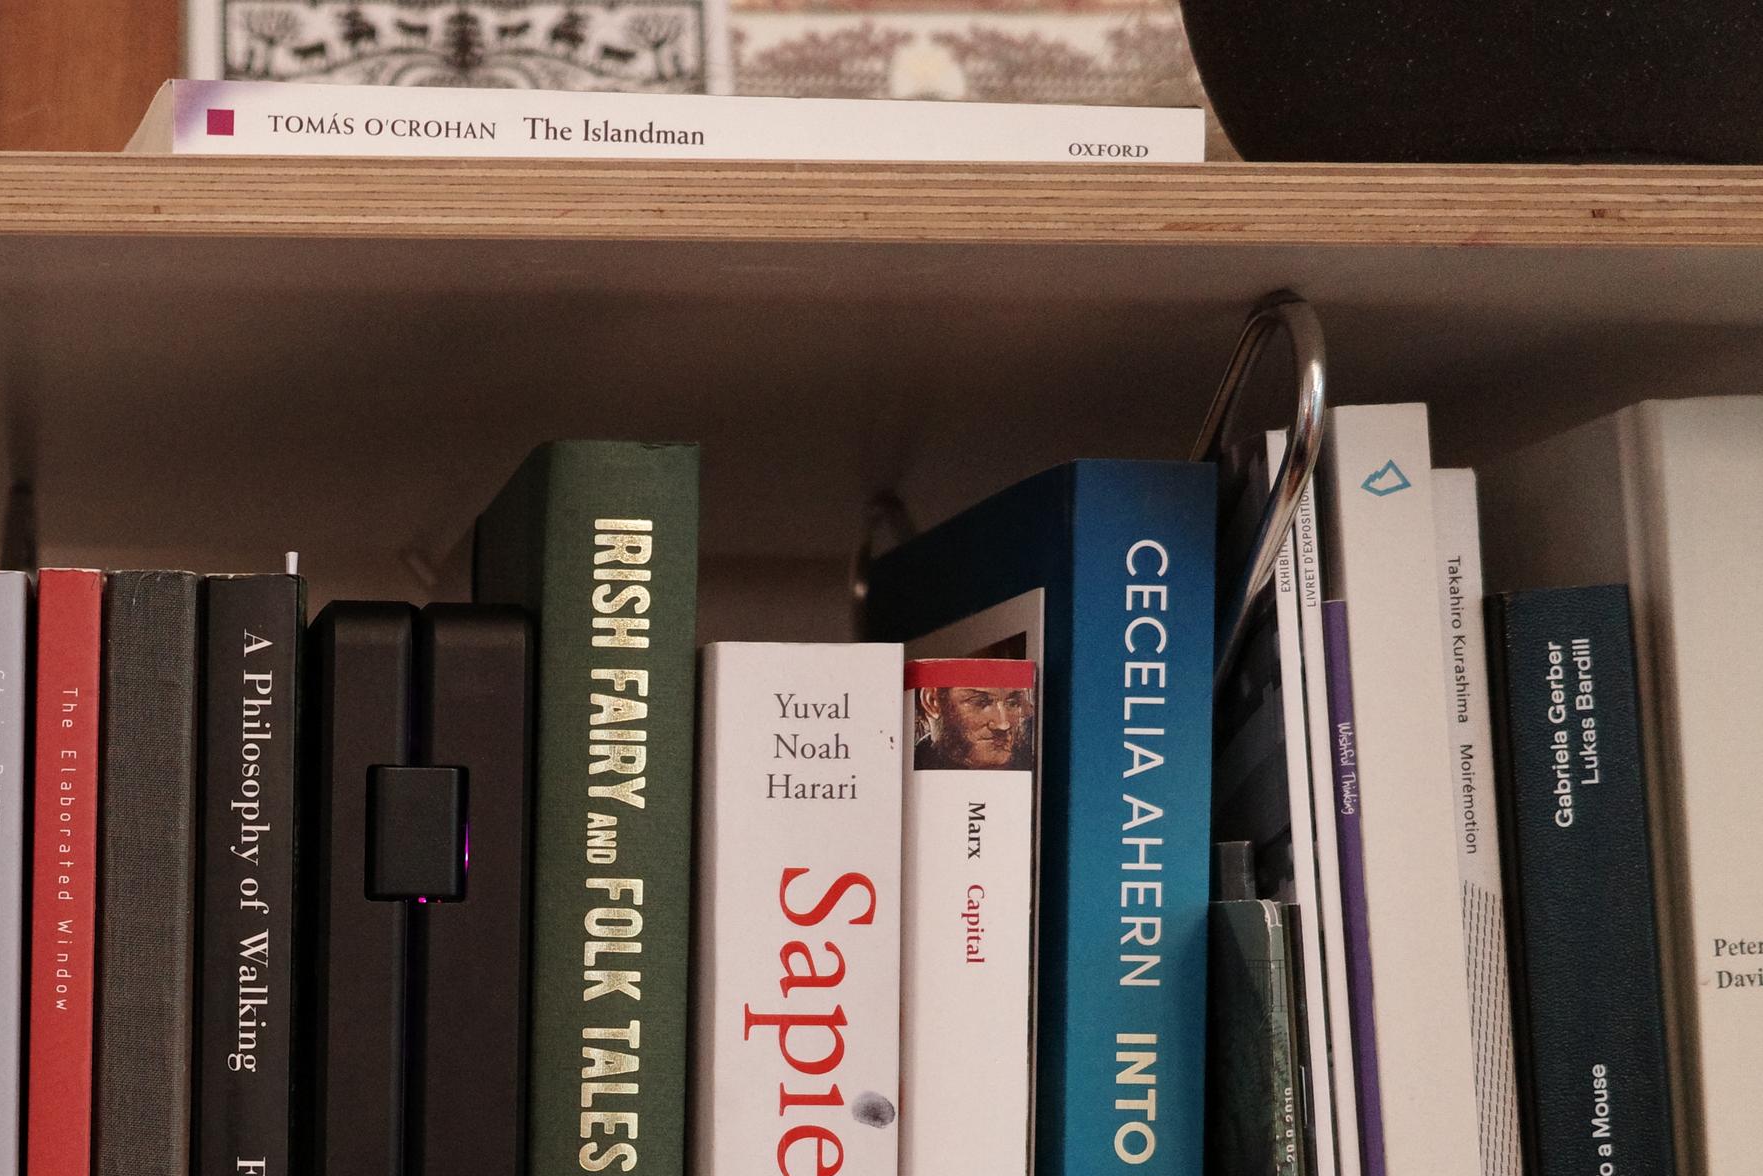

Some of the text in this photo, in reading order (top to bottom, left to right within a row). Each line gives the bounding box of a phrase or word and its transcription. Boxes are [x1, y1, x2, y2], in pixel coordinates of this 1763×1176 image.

[267, 112, 705, 146] TOMÁS O'CROHAN The Islandman
[1067, 141, 1149, 158] OXFORD
[773, 733, 851, 759] Noah
[774, 693, 851, 720] Yuval
[1119, 539, 1169, 988] CECELIA AHERN
[1337, 722, 1357, 815] Wishful Thinking
[1447, 555, 1477, 855] Takahiro Kurashima Moirémotion
[1547, 641, 1573, 828] Gabriela Gerber
[1574, 637, 1600, 785] Lukas Bardill
[55, 687, 79, 1011] The Elaborated Window
[227, 628, 273, 1072] A Philosophy of Walking
[579, 518, 653, 1172] IRISH FAIRY AND FOLK TALES
[766, 774, 858, 800] Harari
[961, 802, 987, 965] Marx Capital
[1113, 1033, 1158, 1164] INTO
[1592, 1063, 1610, 1138] Mouse
[1597, 1143, 1614, 1159] a
